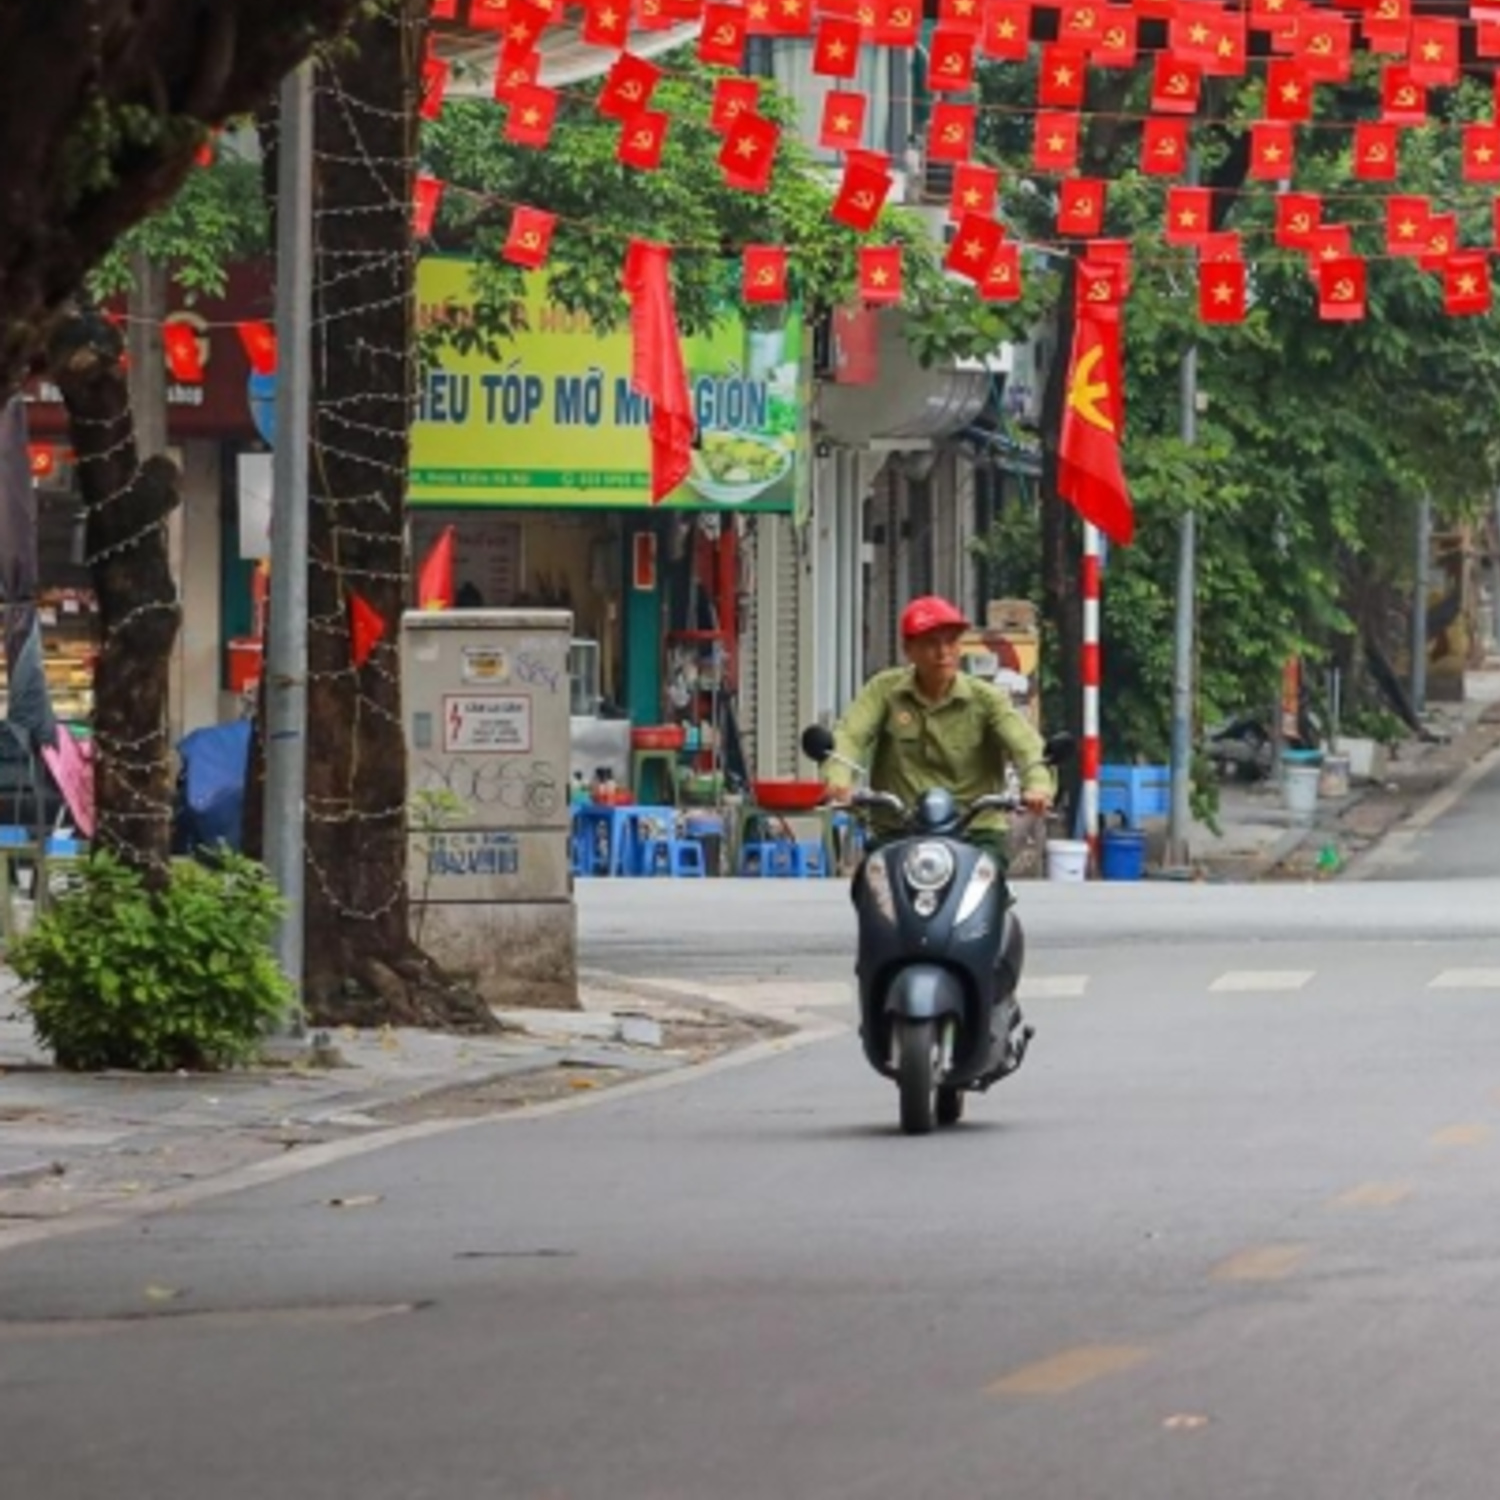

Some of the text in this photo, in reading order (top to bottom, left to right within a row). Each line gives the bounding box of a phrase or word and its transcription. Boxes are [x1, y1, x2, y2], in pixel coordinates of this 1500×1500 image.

[416, 366, 470, 425] IÊU
[481, 359, 544, 426] TÓP
[555, 366, 605, 426] MỠ
[696, 360, 767, 428] GIÒN
